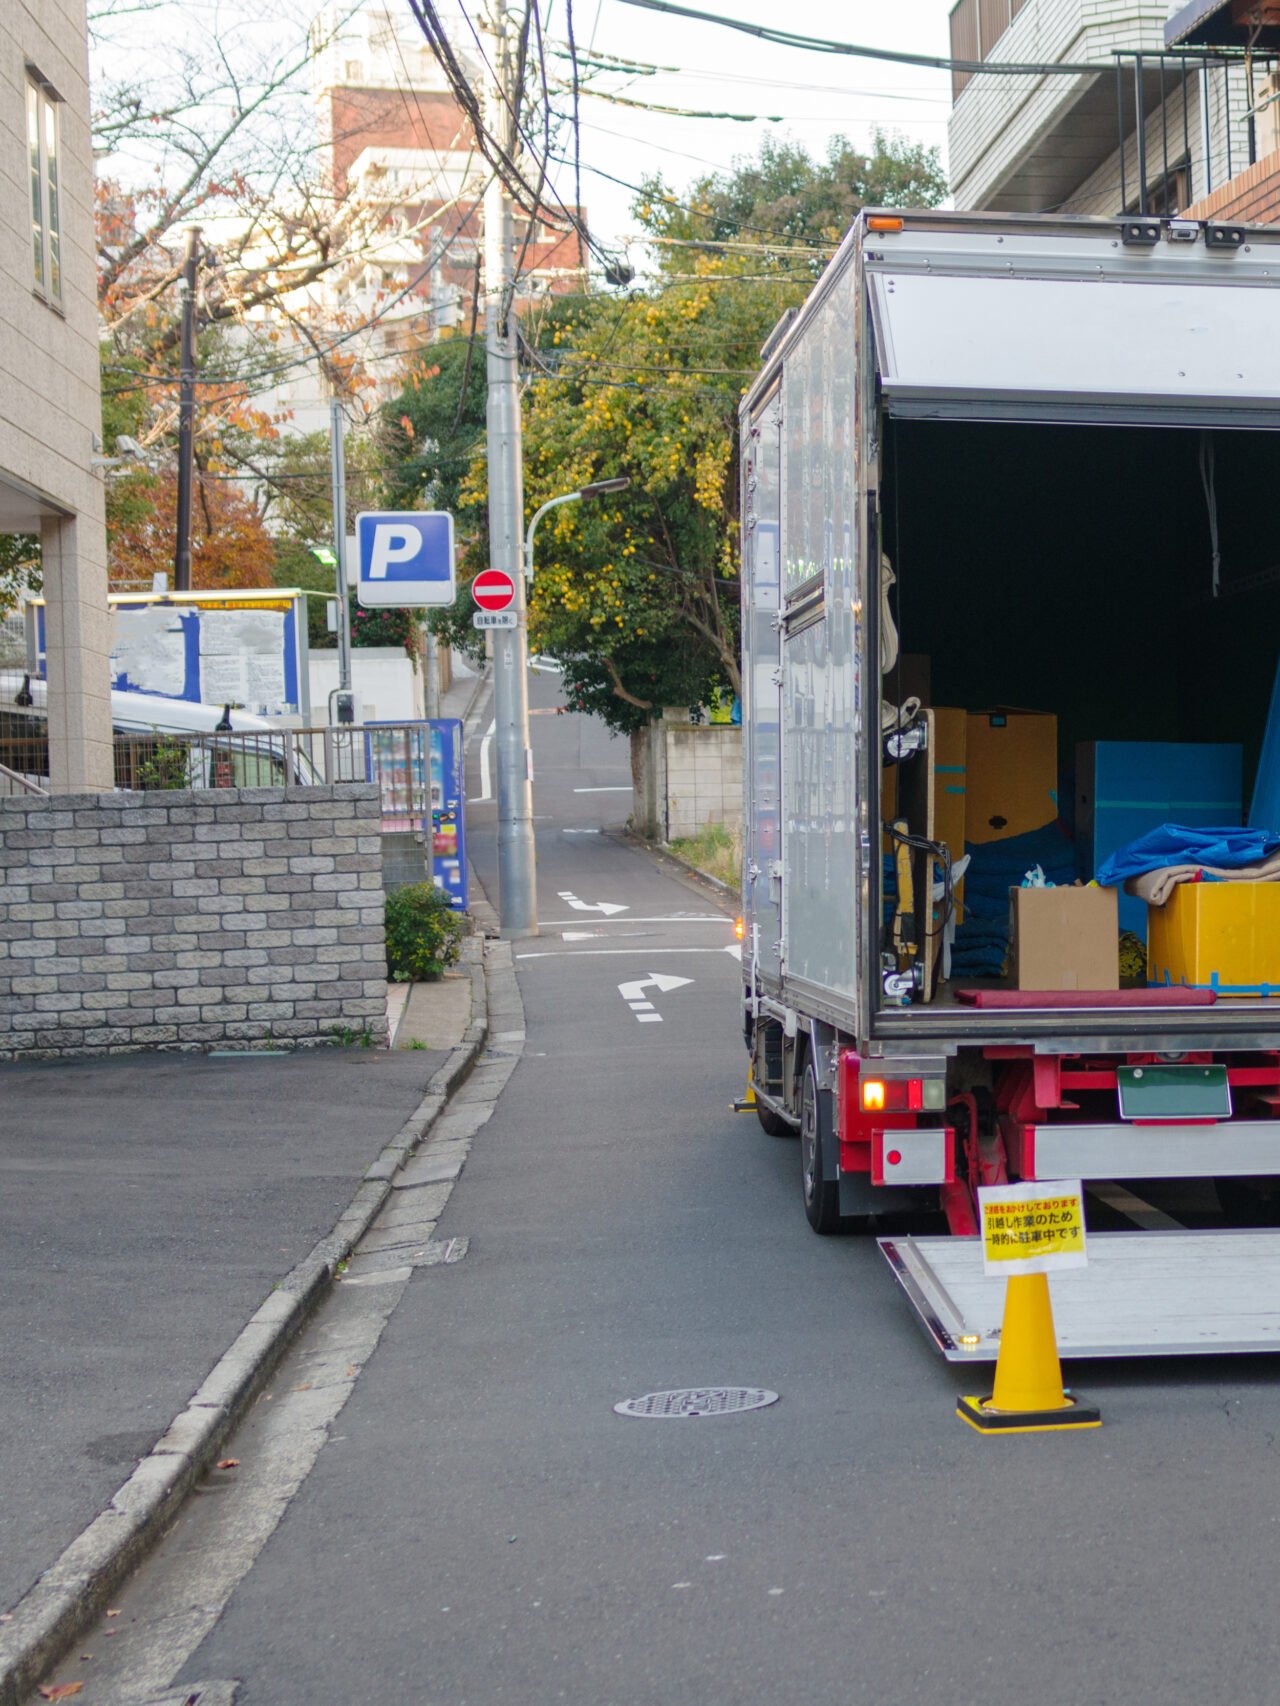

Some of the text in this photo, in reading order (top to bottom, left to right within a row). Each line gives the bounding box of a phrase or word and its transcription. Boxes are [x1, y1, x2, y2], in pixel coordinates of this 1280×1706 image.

[369, 524, 423, 579] P
[988, 1211, 1073, 1230] 引越し作業のため
[985, 1226, 1081, 1246] 一時的に駐車中です
